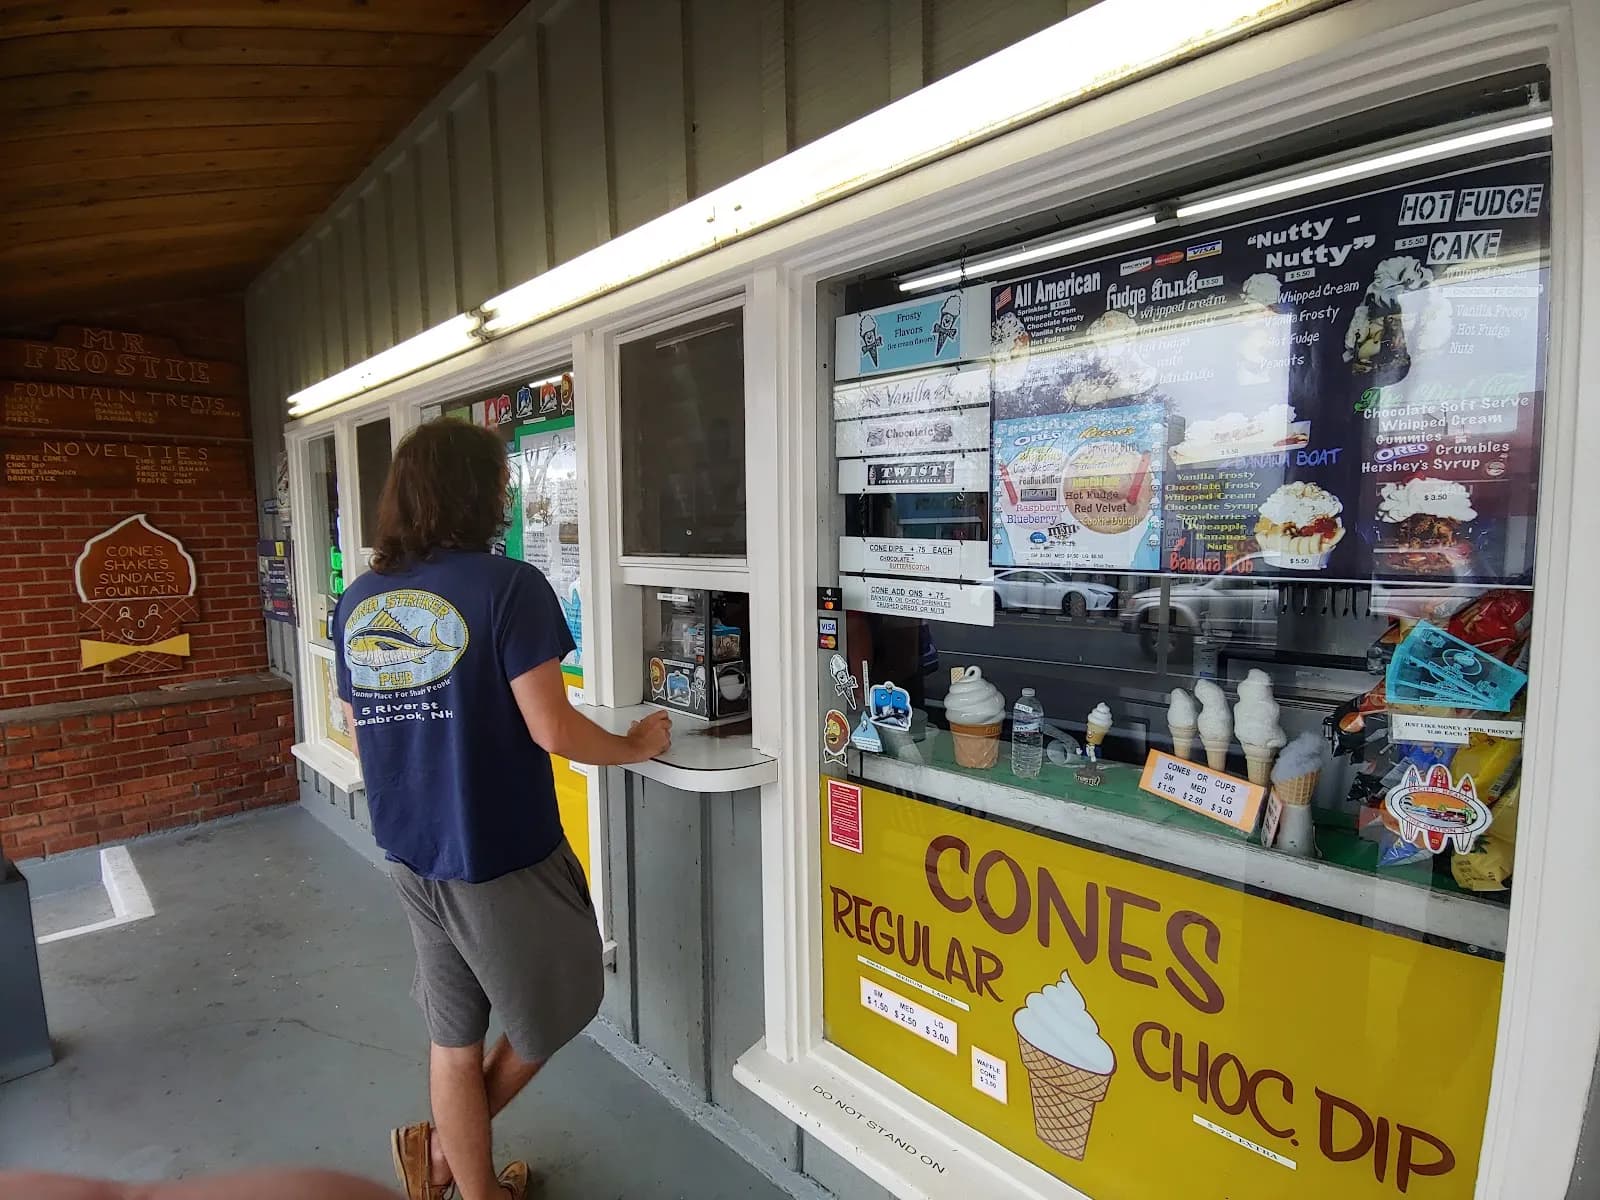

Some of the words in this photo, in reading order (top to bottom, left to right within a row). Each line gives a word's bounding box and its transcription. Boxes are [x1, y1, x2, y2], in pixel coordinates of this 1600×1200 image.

[1399, 193, 1455, 224] HOT
[1457, 187, 1543, 219] FUDGE
[1429, 231, 1500, 262] CAKE
[1014, 280, 1033, 308] All
[1035, 271, 1100, 304] American
[1278, 285, 1321, 305] Whipped
[1323, 282, 1359, 296] Cream
[1106, 283, 1146, 318] fudge
[897, 311, 922, 323] Frosty
[1017, 304, 1047, 317] Sprinkles
[1023, 311, 1051, 323] Whipped
[1053, 307, 1076, 316] Cream
[1299, 305, 1340, 323] Frosty
[1027, 319, 1060, 330] Chocolate
[1062, 314, 1084, 324] Frosty
[895, 327, 923, 338] Flavors
[1031, 330, 1053, 338] Vanilla
[1055, 324, 1077, 334] Frosty
[1456, 324, 1476, 335] Hot
[1044, 335, 1065, 344] Fudge
[1290, 332, 1320, 346] Fudge
[1449, 342, 1474, 354] Nuts
[23, 344, 210, 384] FROSTIE
[13, 382, 137, 405] FOUNTAIN
[145, 391, 226, 410] TREATS
[885, 378, 931, 407] Vanilla
[1364, 404, 1436, 420] Chocolate
[1440, 399, 1479, 413] Soft
[1481, 396, 1529, 409] Serve
[1381, 417, 1446, 432] Whipped
[1452, 413, 1503, 426] Cream
[885, 427, 934, 439] Chocolate
[1014, 431, 1062, 448] OREO
[1376, 432, 1442, 445] Gummies
[42, 441, 209, 461] NOVELTIES
[1296, 448, 1343, 467] BOAT
[1376, 443, 1428, 461] OREO
[1436, 442, 1510, 456] Crumbles
[881, 465, 942, 478] TWIST
[1361, 460, 1429, 474] Hershey's
[1433, 459, 1480, 471] Syrup
[1177, 472, 1215, 481] Vanilla
[1218, 471, 1255, 482] Frosty
[1165, 482, 1221, 492] Chocolate
[1224, 482, 1262, 492] Frosty
[1065, 491, 1083, 500] Hot
[1087, 491, 1119, 501] Fudge
[1164, 493, 1213, 503] Whipped
[1217, 492, 1256, 500] Cream
[1016, 503, 1068, 513] Raspberry
[1074, 504, 1092, 513] Red
[1096, 503, 1127, 513] Velvet
[1164, 503, 1220, 511] Chocolate
[1223, 502, 1258, 512] Syrup
[1007, 514, 1057, 525] Blueberry
[1175, 512, 1247, 521] Strawberries
[1195, 532, 1247, 541] Bananas
[105, 546, 164, 558] CONES
[869, 544, 888, 552] CONE
[888, 544, 904, 553] DIPS
[932, 546, 953, 555] EACH
[1206, 543, 1234, 551] Nuts
[103, 559, 169, 572] SHAKES
[1170, 551, 1221, 572] Banana
[99, 571, 176, 585] SUNDAES
[94, 584, 179, 598] FOUNTAIN
[871, 586, 889, 595] CONE
[891, 588, 906, 596] ADD
[908, 589, 923, 598] ONS
[821, 623, 836, 631] VISA
[379, 671, 414, 687] PUB
[374, 692, 393, 700] Place
[395, 690, 408, 699] For
[362, 706, 372, 715] 5
[375, 703, 419, 714] River
[420, 701, 440, 711] St
[431, 710, 454, 721] NH
[1437, 724, 1462, 732] MONEY
[1167, 762, 1191, 776] CONES
[1197, 773, 1209, 783] OR
[1215, 780, 1236, 793] CUPS
[1163, 772, 1174, 781] SM
[1190, 783, 1207, 794] MED
[1221, 794, 1233, 805] LG
[925, 834, 1225, 1014] CONES
[830, 885, 1004, 1003] REGULAR
[873, 989, 884, 999] SM
[900, 1002, 915, 1015] MED
[934, 1018, 945, 1030] LG
[976, 1058, 1001, 1074] WAFFLE
[979, 1068, 997, 1081] CONE
[812, 1085, 833, 1100] DO
[835, 1100, 866, 1120] NOT
[866, 1120, 917, 1155] STAND
[920, 1155, 945, 1174] ON
[1315, 1085, 1456, 1193] DIP
[1239, 1138, 1279, 1160] EXTRA
